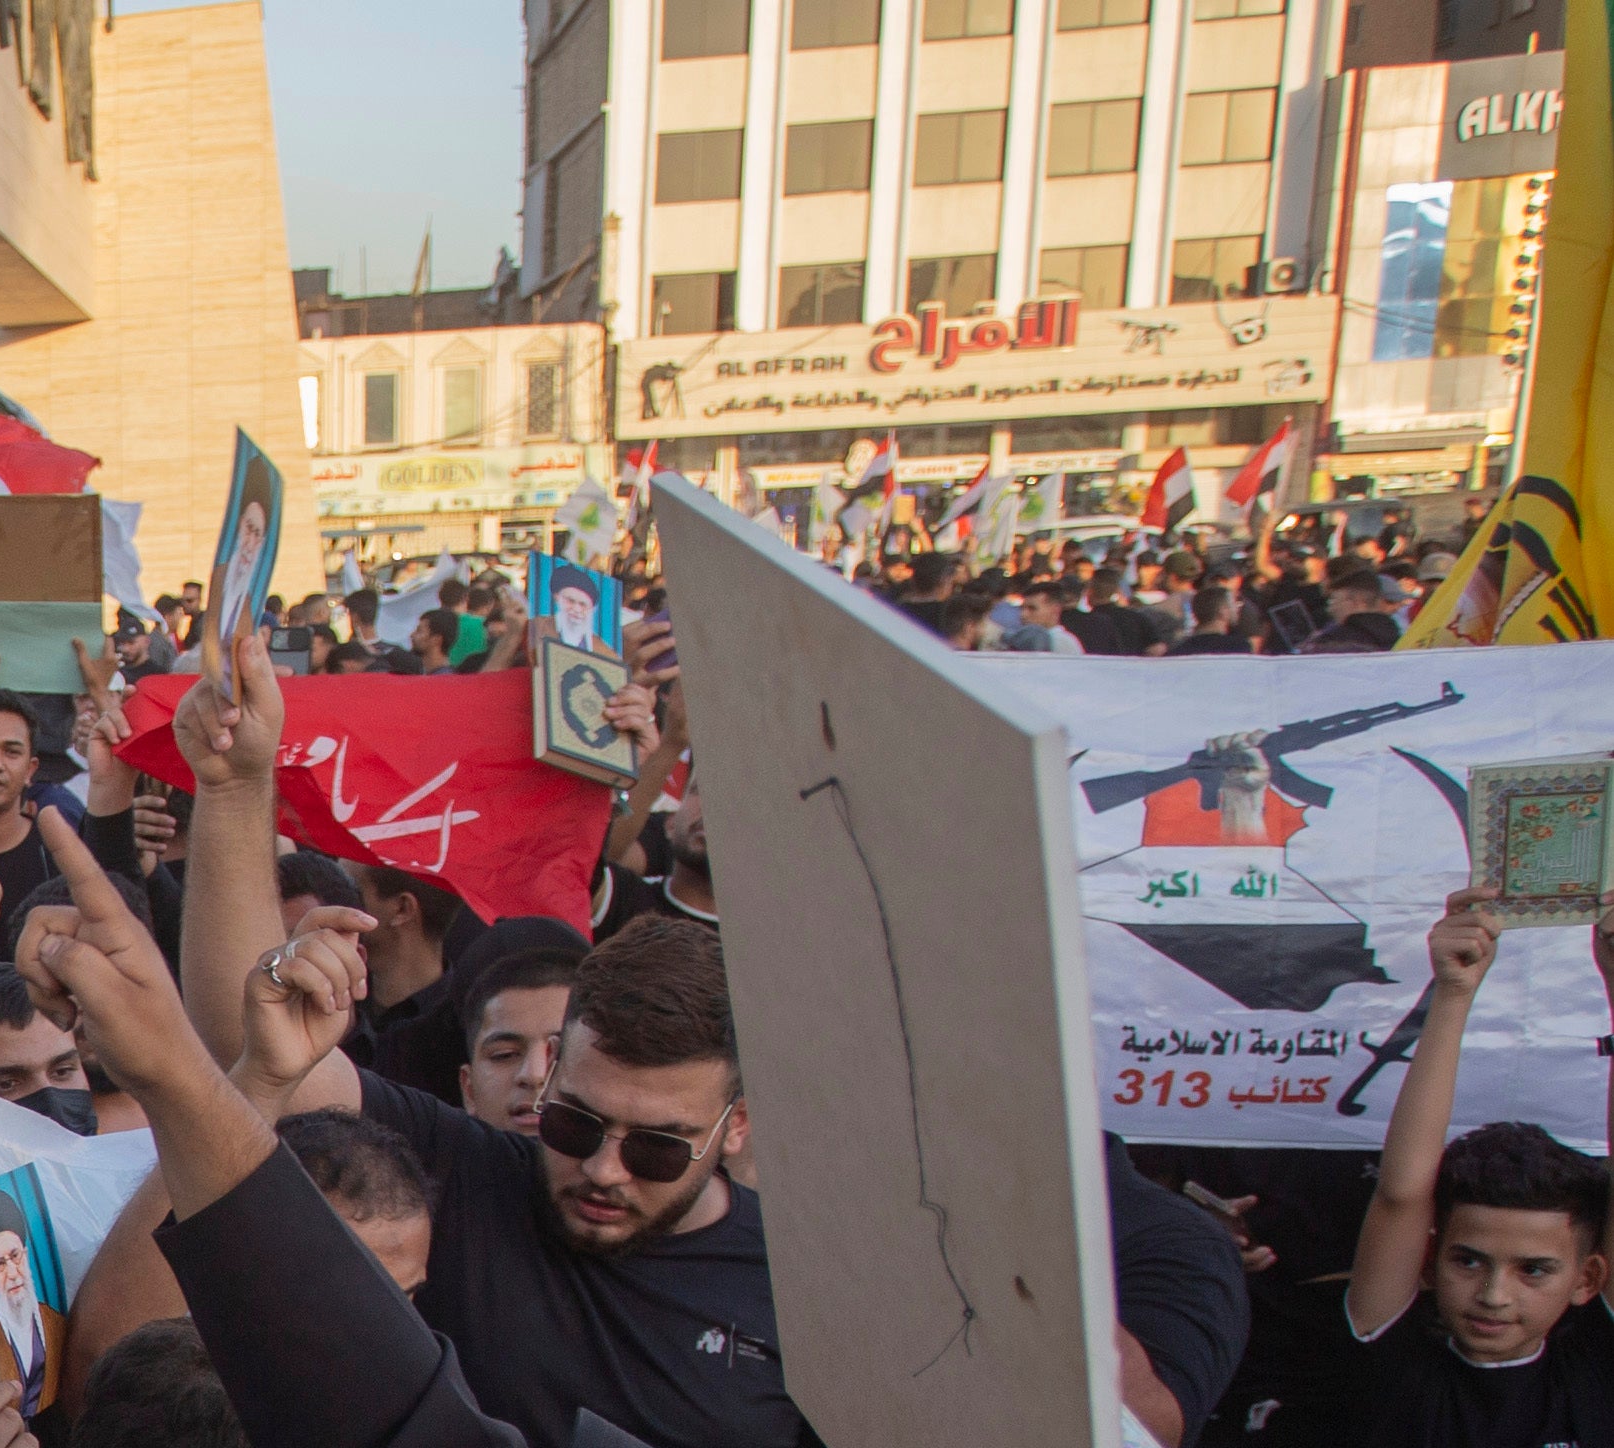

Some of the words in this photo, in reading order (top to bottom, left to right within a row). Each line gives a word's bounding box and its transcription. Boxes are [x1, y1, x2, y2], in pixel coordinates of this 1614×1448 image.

[754, 355, 846, 377] AFRAH
[385, 461, 478, 484] GOLDEN
[1136, 869, 1200, 909] اكبر
[1230, 864, 1279, 898] الله
[1121, 1025, 1241, 1063] الاسلامية
[1247, 1026, 1349, 1064] المقاومة
[1113, 1067, 1213, 1108] 313
[1227, 1076, 1333, 1110] كتائب
